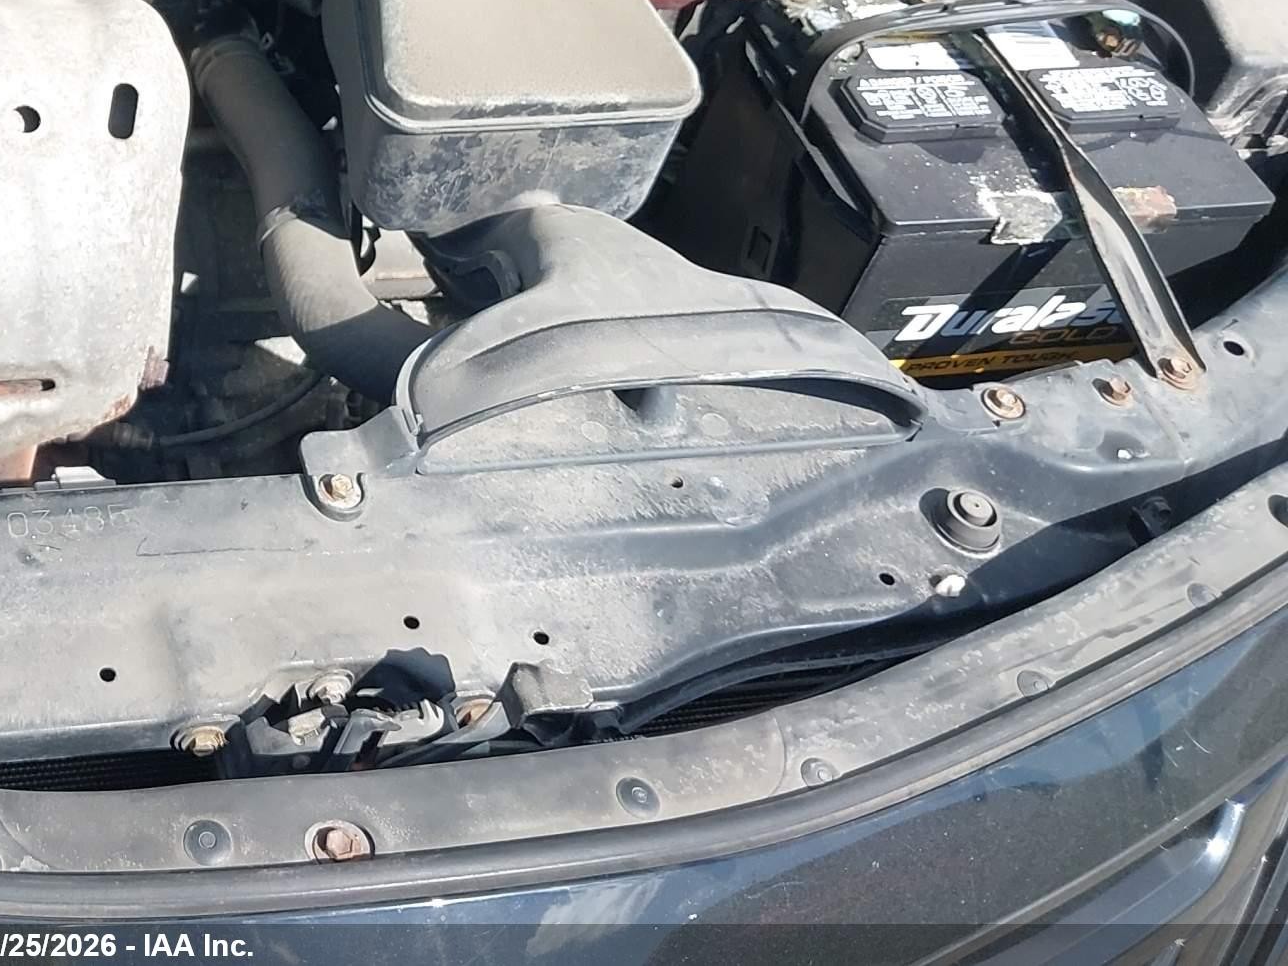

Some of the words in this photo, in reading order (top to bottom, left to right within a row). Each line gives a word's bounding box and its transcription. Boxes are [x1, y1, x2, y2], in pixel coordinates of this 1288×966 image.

[1009, 326, 1118, 345] GOLD
[906, 356, 996, 373] PROVEN
[1002, 350, 1079, 366] TOUGH
